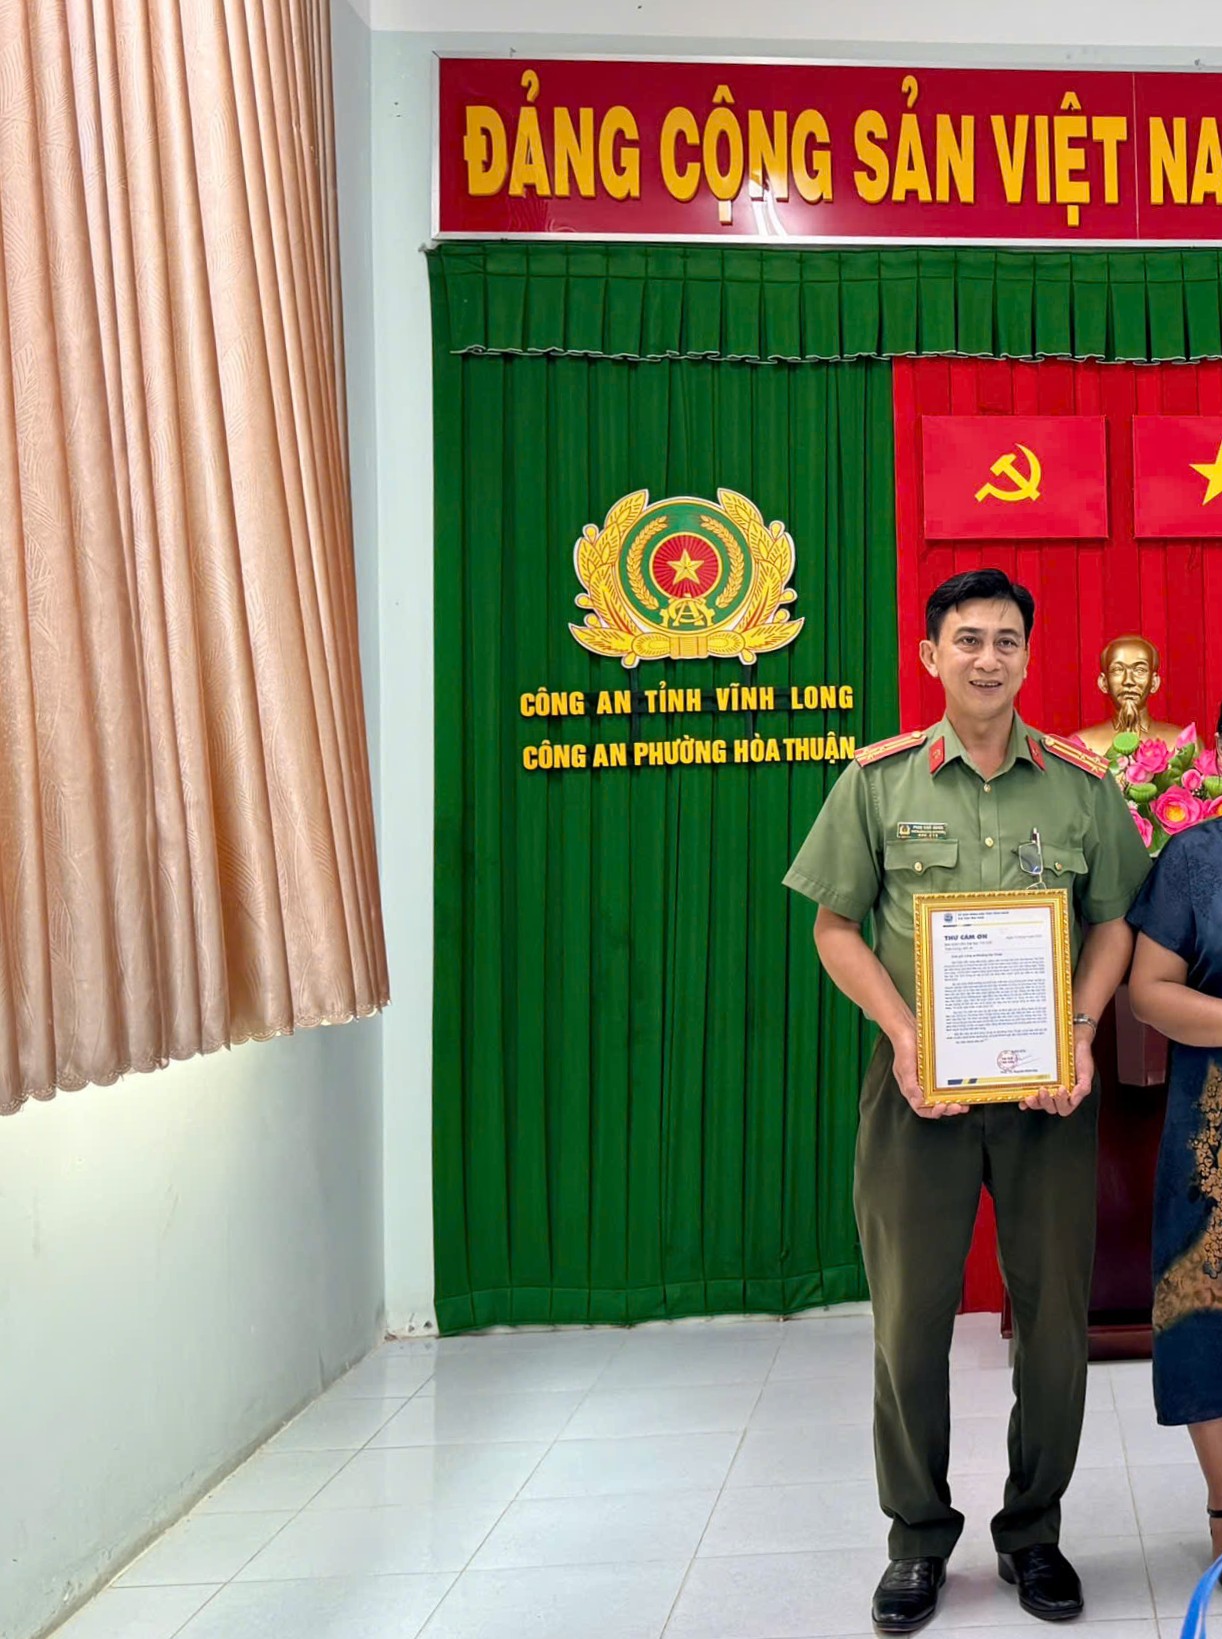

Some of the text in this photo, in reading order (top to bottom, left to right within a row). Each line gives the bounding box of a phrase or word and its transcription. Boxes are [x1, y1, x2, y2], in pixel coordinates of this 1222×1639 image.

[464, 70, 640, 200] ĐẢNG
[661, 85, 833, 226] CỘNG
[854, 75, 975, 204] SẢN
[991, 92, 1127, 226] VIỆT
[520, 681, 853, 717] CÔNG AN TỈNH VĨNH LONG
[522, 731, 855, 770] CÔNG AN PHƯỜNG HÒA THUẬN
